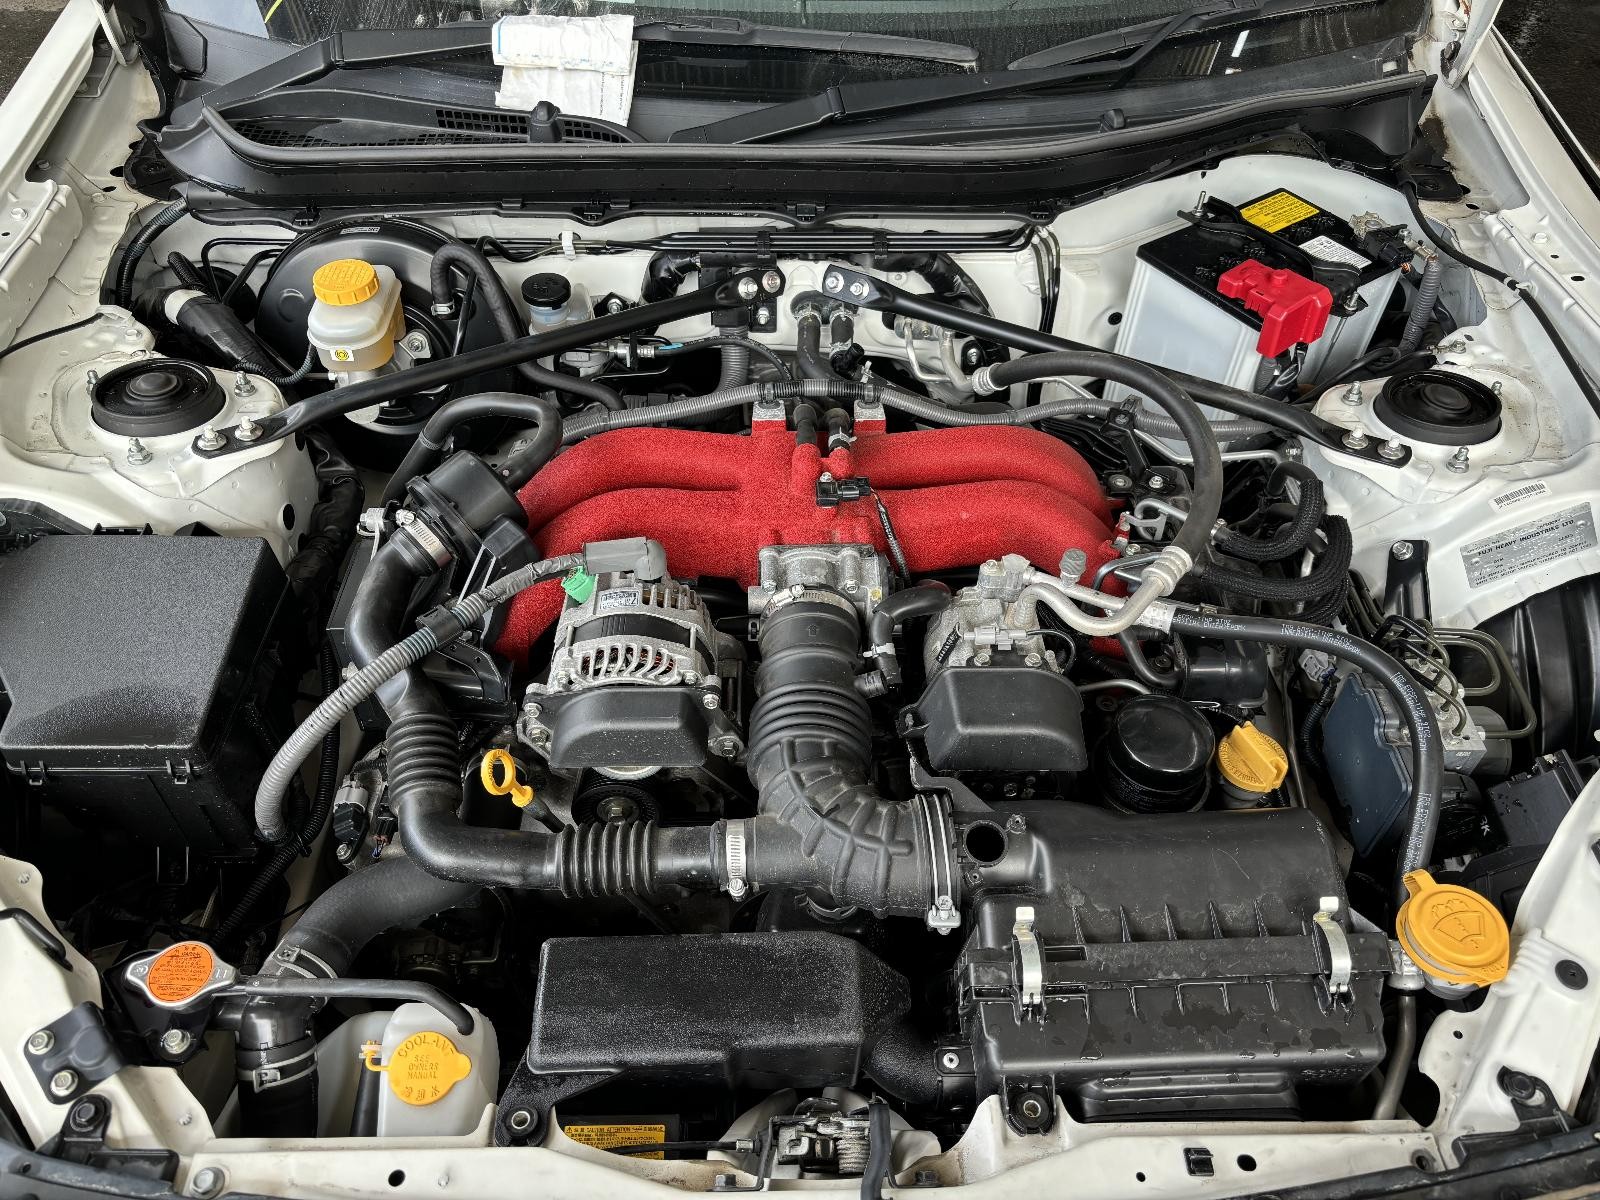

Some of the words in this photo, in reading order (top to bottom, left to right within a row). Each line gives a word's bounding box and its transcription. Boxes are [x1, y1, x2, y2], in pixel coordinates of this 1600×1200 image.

[1478, 547, 1493, 556] FUJI
[1495, 540, 1516, 550] HEAVY
[398, 1034, 455, 1058] COOLANT
[408, 1072, 438, 1080] MANUAL
